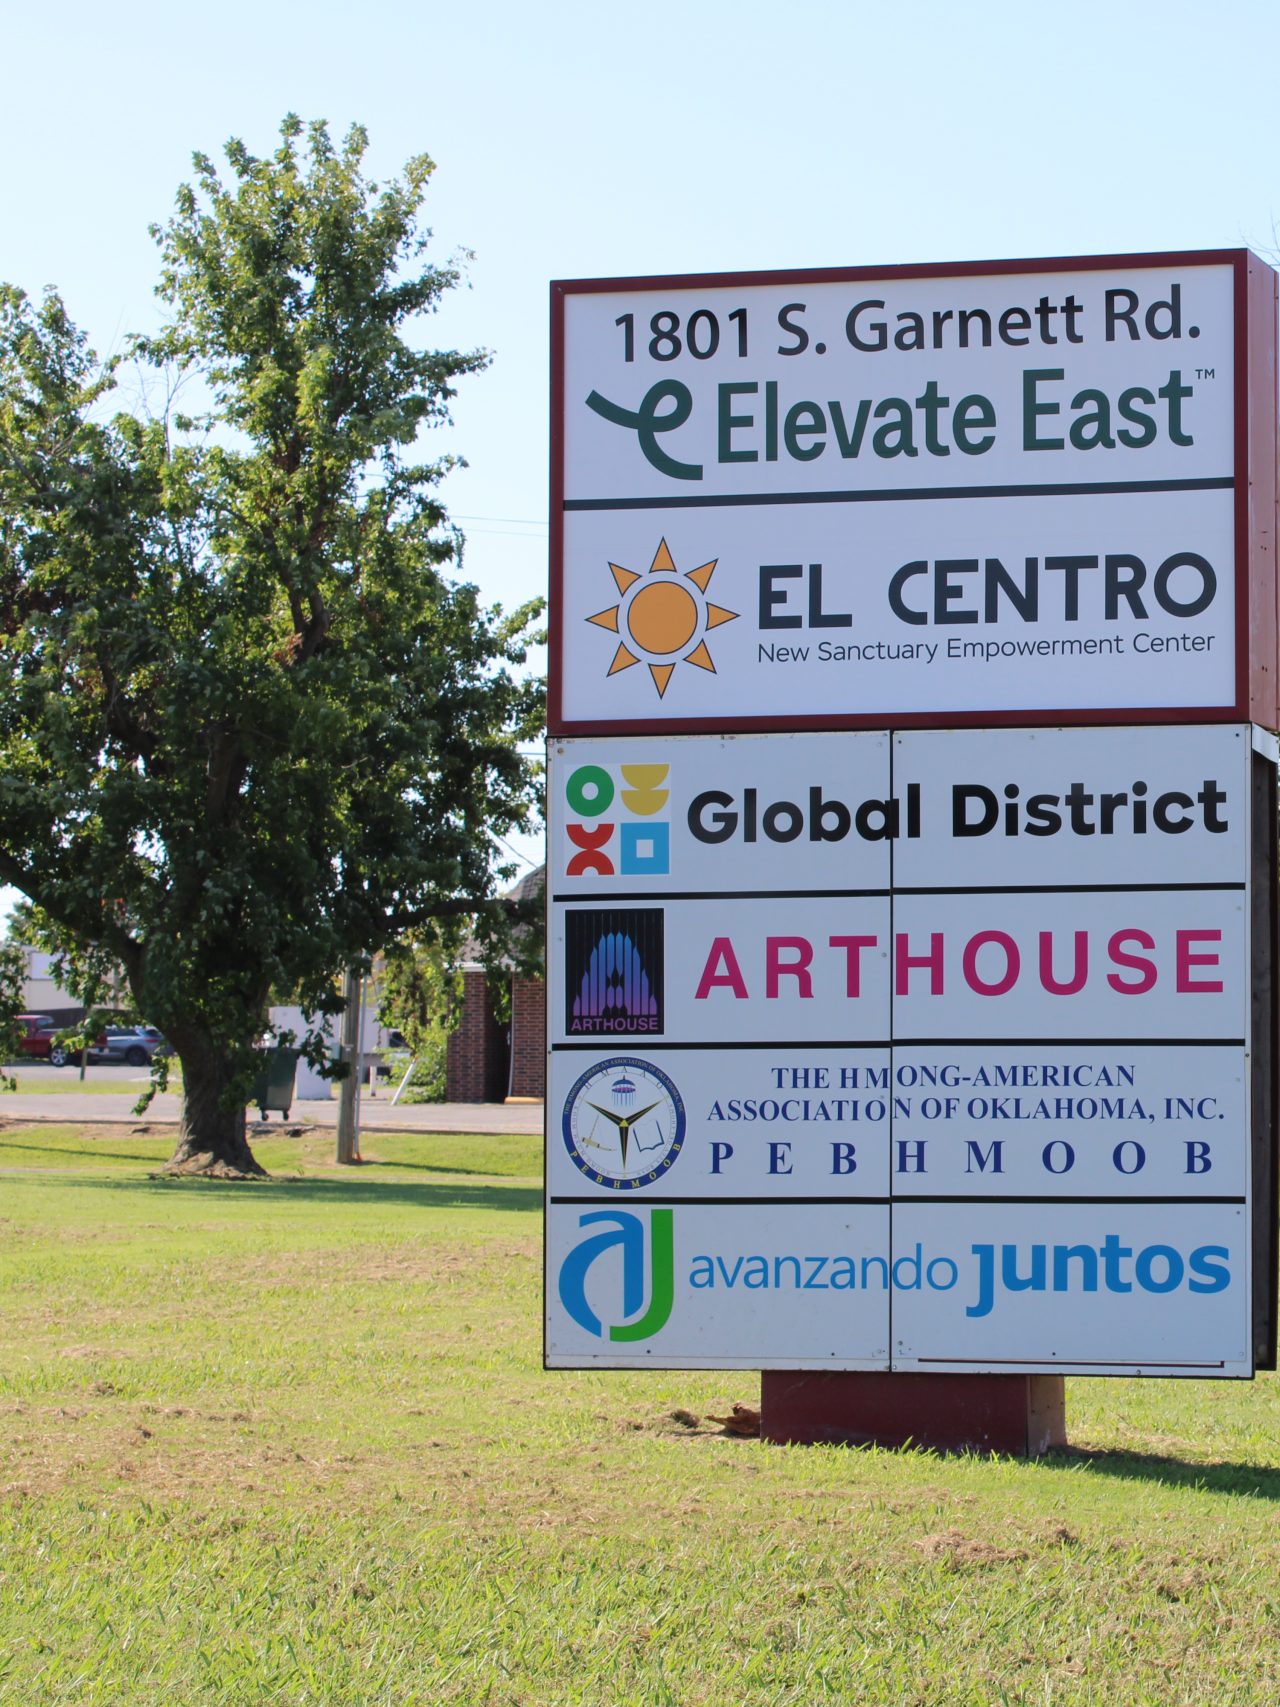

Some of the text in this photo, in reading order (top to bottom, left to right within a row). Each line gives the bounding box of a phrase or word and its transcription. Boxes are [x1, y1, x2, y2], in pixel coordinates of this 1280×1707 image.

[614, 283, 1201, 363] 1801 S. Garnett Rd.
[717, 380, 997, 464] Elevate
[1022, 367, 1195, 452] East
[758, 551, 1218, 630] EL CENTRO
[758, 631, 1217, 665] New Sanctuary Empowerment Center
[686, 779, 1229, 845] Global District
[694, 928, 1225, 1000] ARTHOUSE
[571, 1017, 659, 1032] ARTHOUSE
[706, 1096, 1226, 1125] ASSOCIATION OF OKLAHOMA, INC.
[770, 1066, 831, 1089] THE
[688, 1234, 1232, 1319] avanzando juntos
